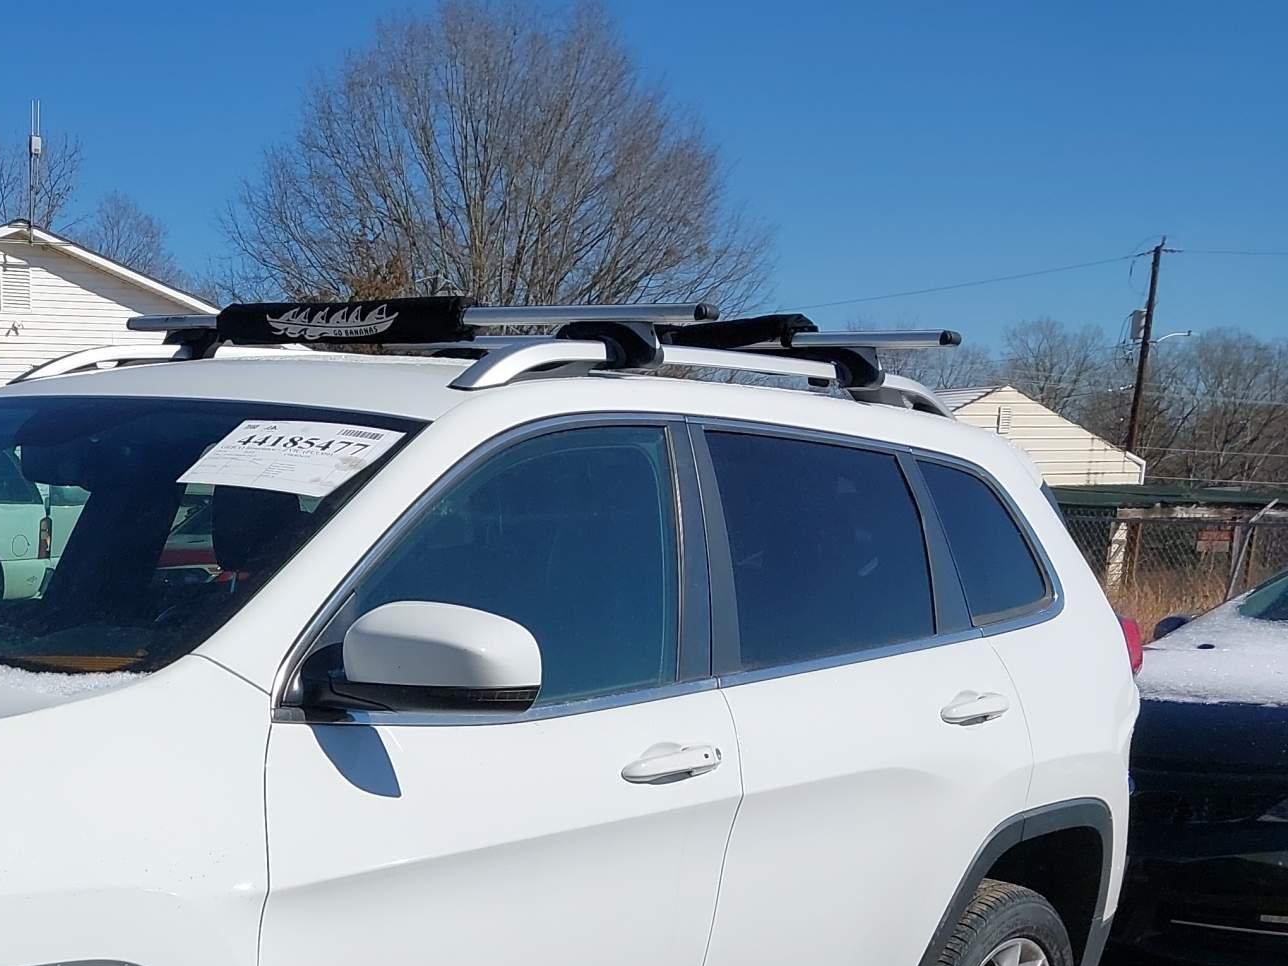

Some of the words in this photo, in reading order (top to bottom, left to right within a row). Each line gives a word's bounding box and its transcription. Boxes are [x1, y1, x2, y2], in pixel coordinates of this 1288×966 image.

[332, 327, 344, 336] GO
[345, 325, 379, 336] BANANAS
[238, 434, 370, 456] 44185477
